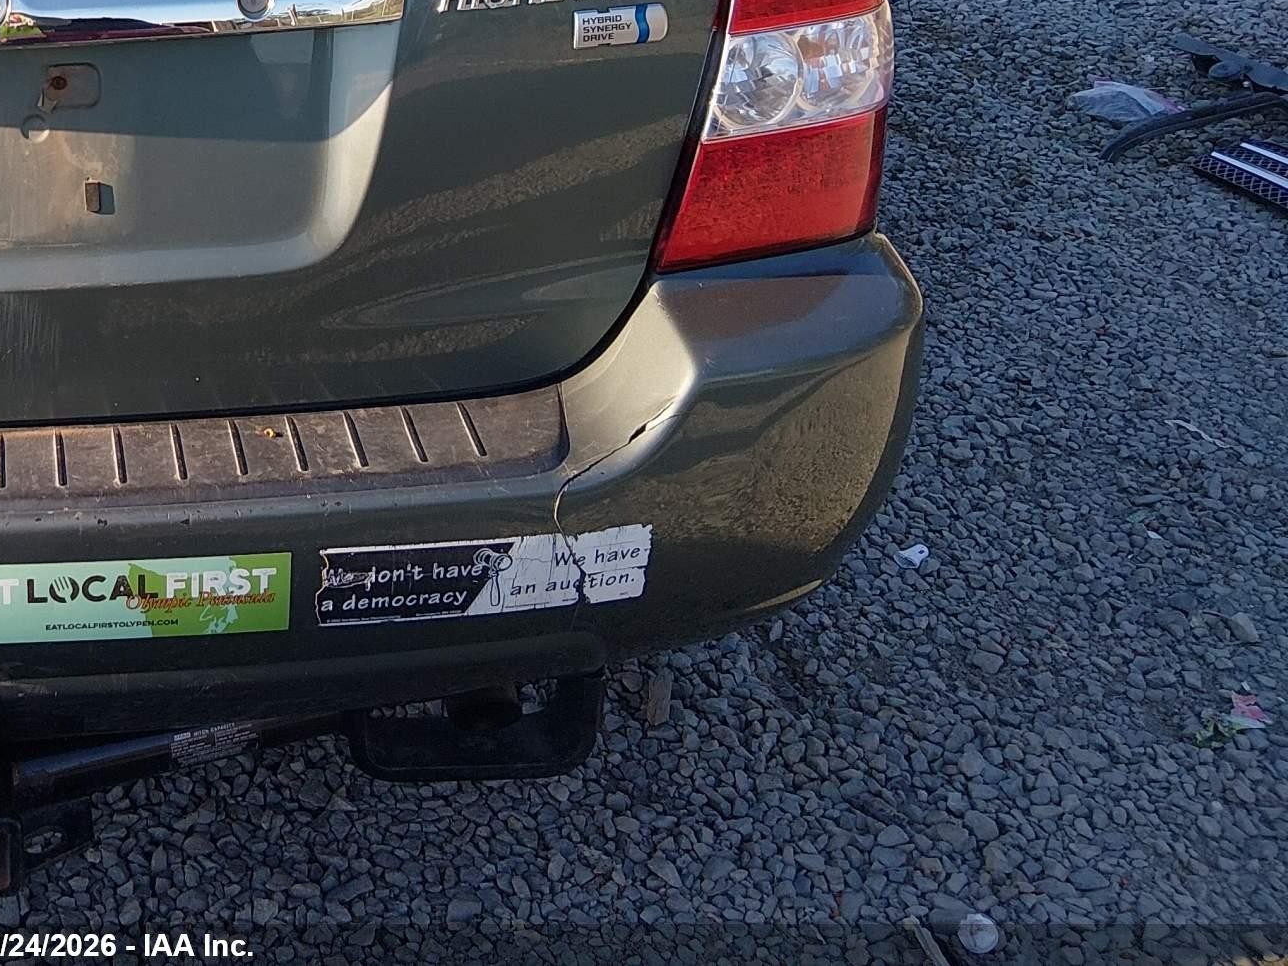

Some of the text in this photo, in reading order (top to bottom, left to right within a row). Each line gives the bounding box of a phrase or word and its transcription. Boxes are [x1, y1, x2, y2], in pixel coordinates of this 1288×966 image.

[582, 15, 622, 25] HYBRID
[583, 22, 632, 34] SYNERGY
[583, 33, 615, 42] DRIVE
[554, 547, 641, 567] We have
[432, 562, 483, 579] have
[27, 574, 159, 604] LOCAL
[166, 568, 277, 599] FIRST
[511, 584, 536, 596] an
[321, 590, 468, 611] a democracy
[45, 618, 179, 631] EATLOCALFIRSTOLYPEN.COM
